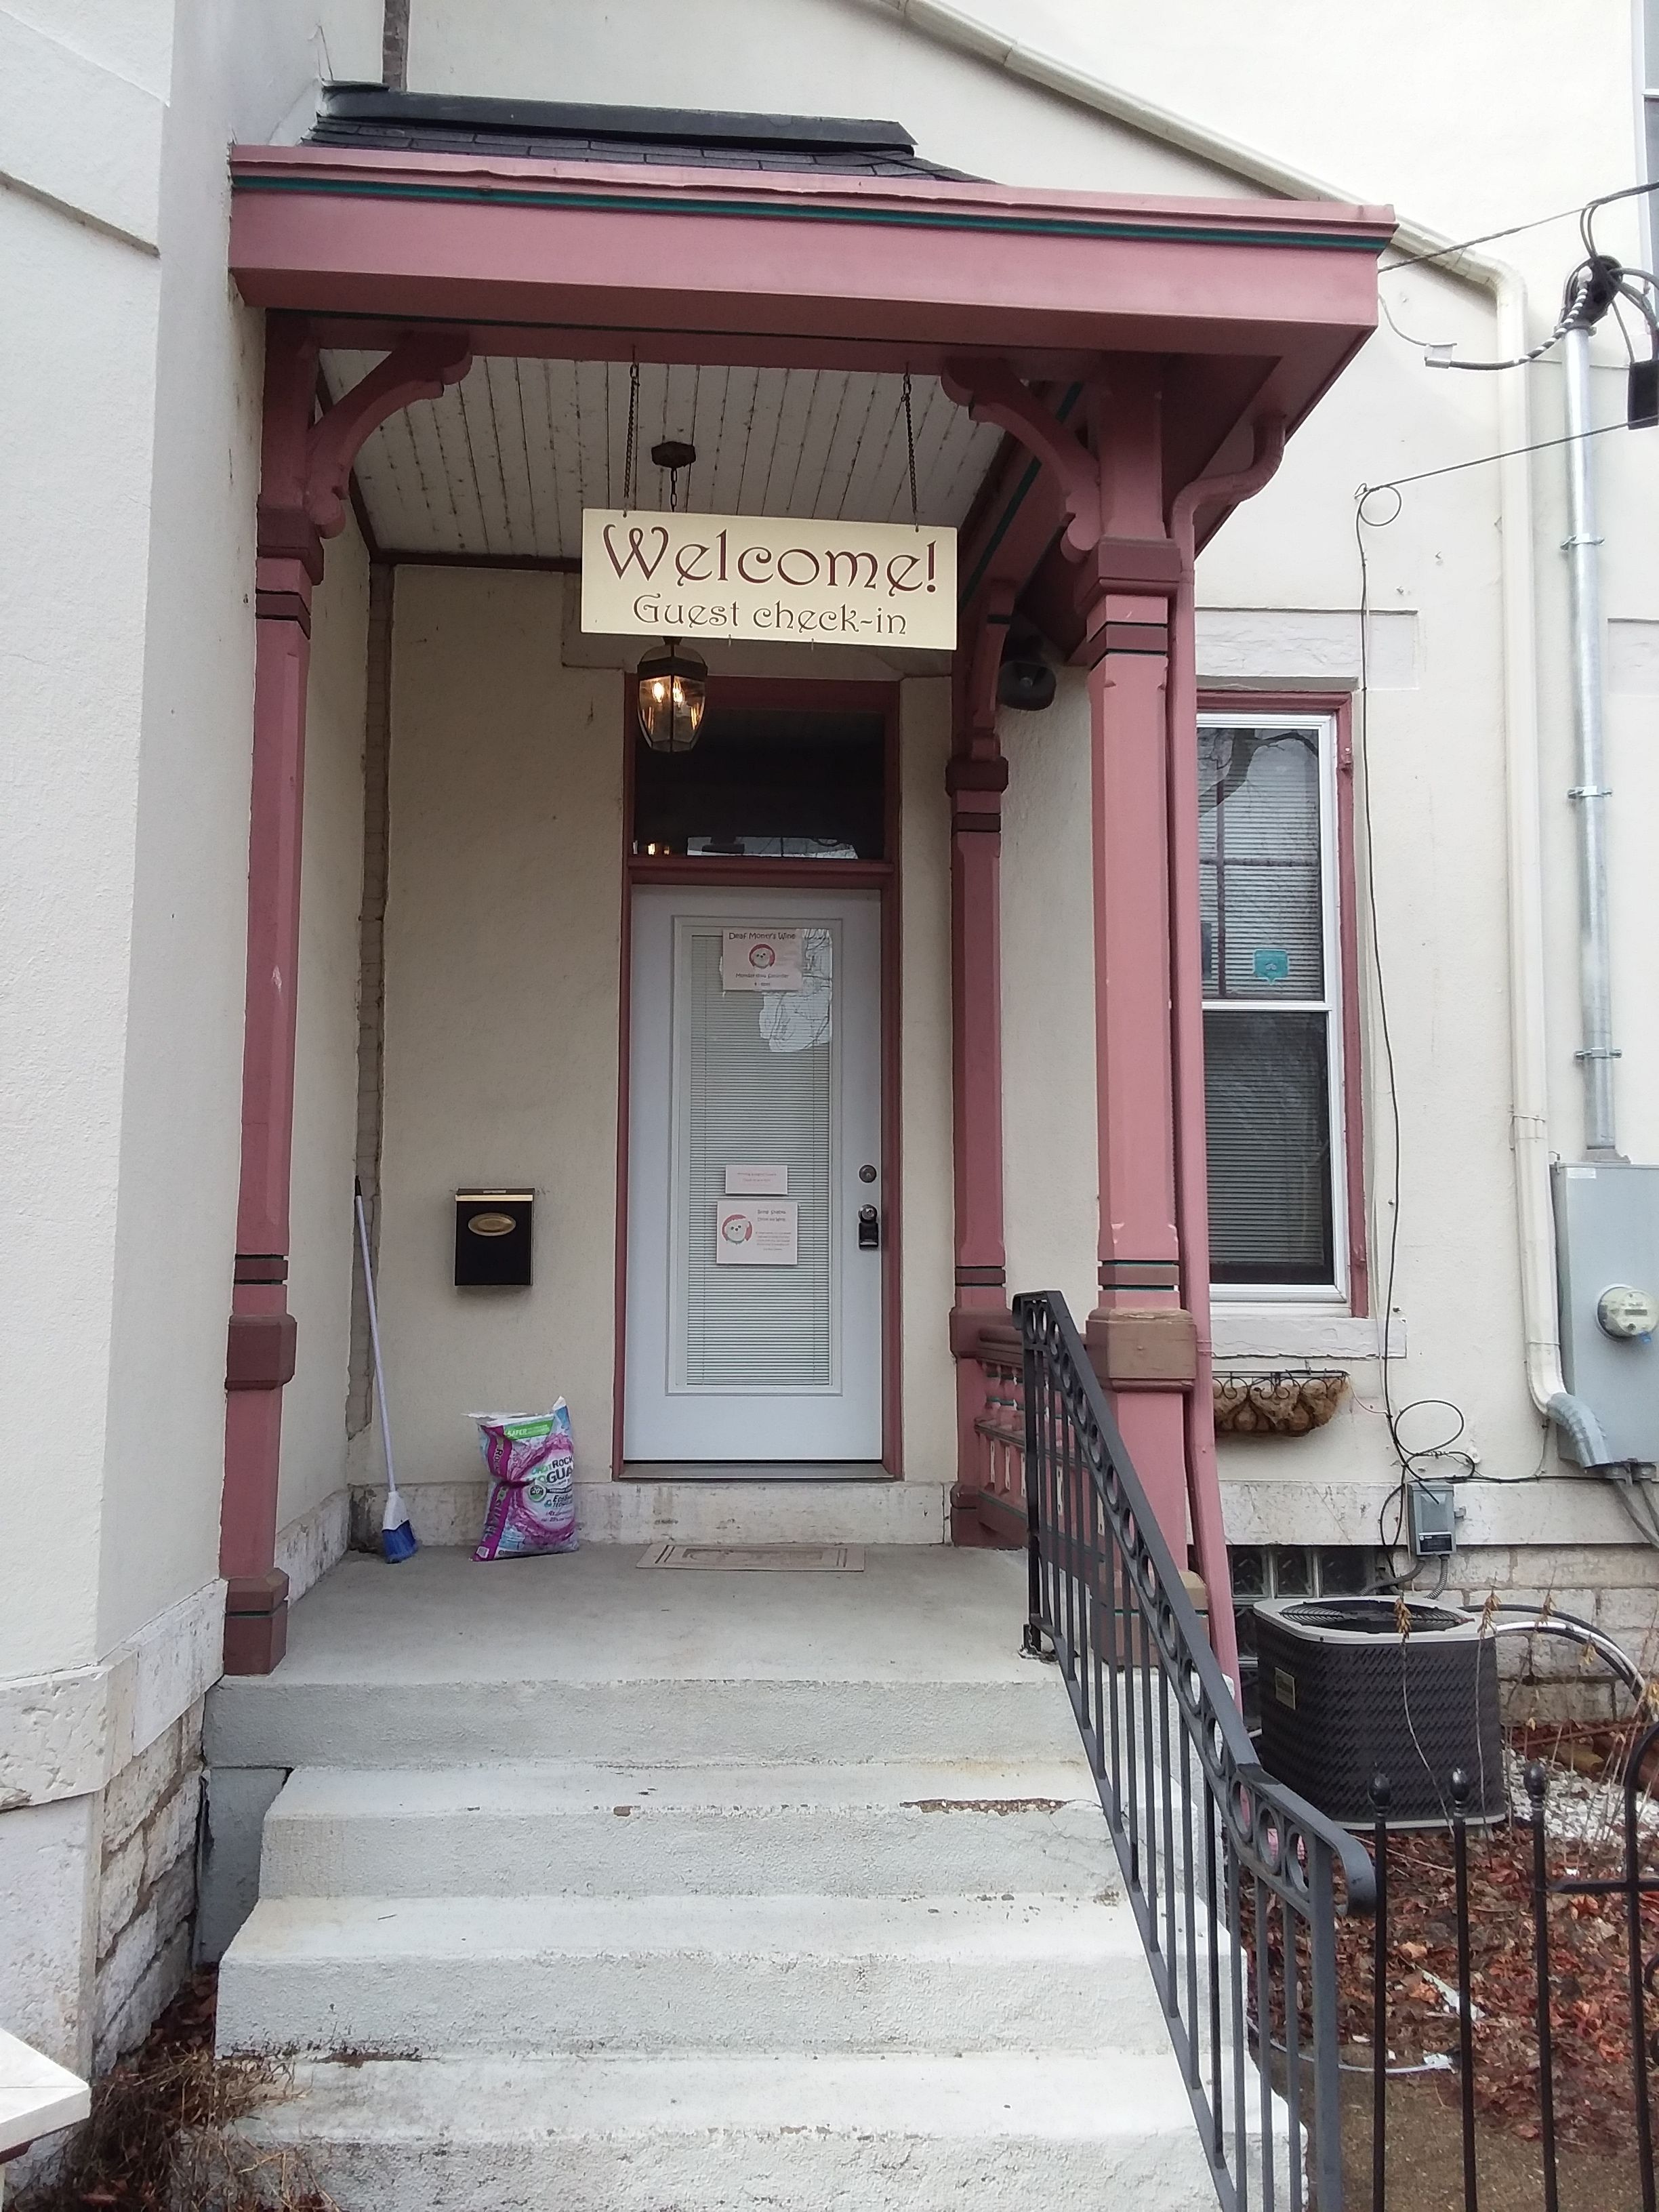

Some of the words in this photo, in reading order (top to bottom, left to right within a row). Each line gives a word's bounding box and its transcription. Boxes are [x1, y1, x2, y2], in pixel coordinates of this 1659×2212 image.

[603, 524, 936, 596] Welcome!
[633, 593, 740, 628] Guest
[753, 600, 907, 635] check-in
[552, 1456, 573, 1469] ROCK
